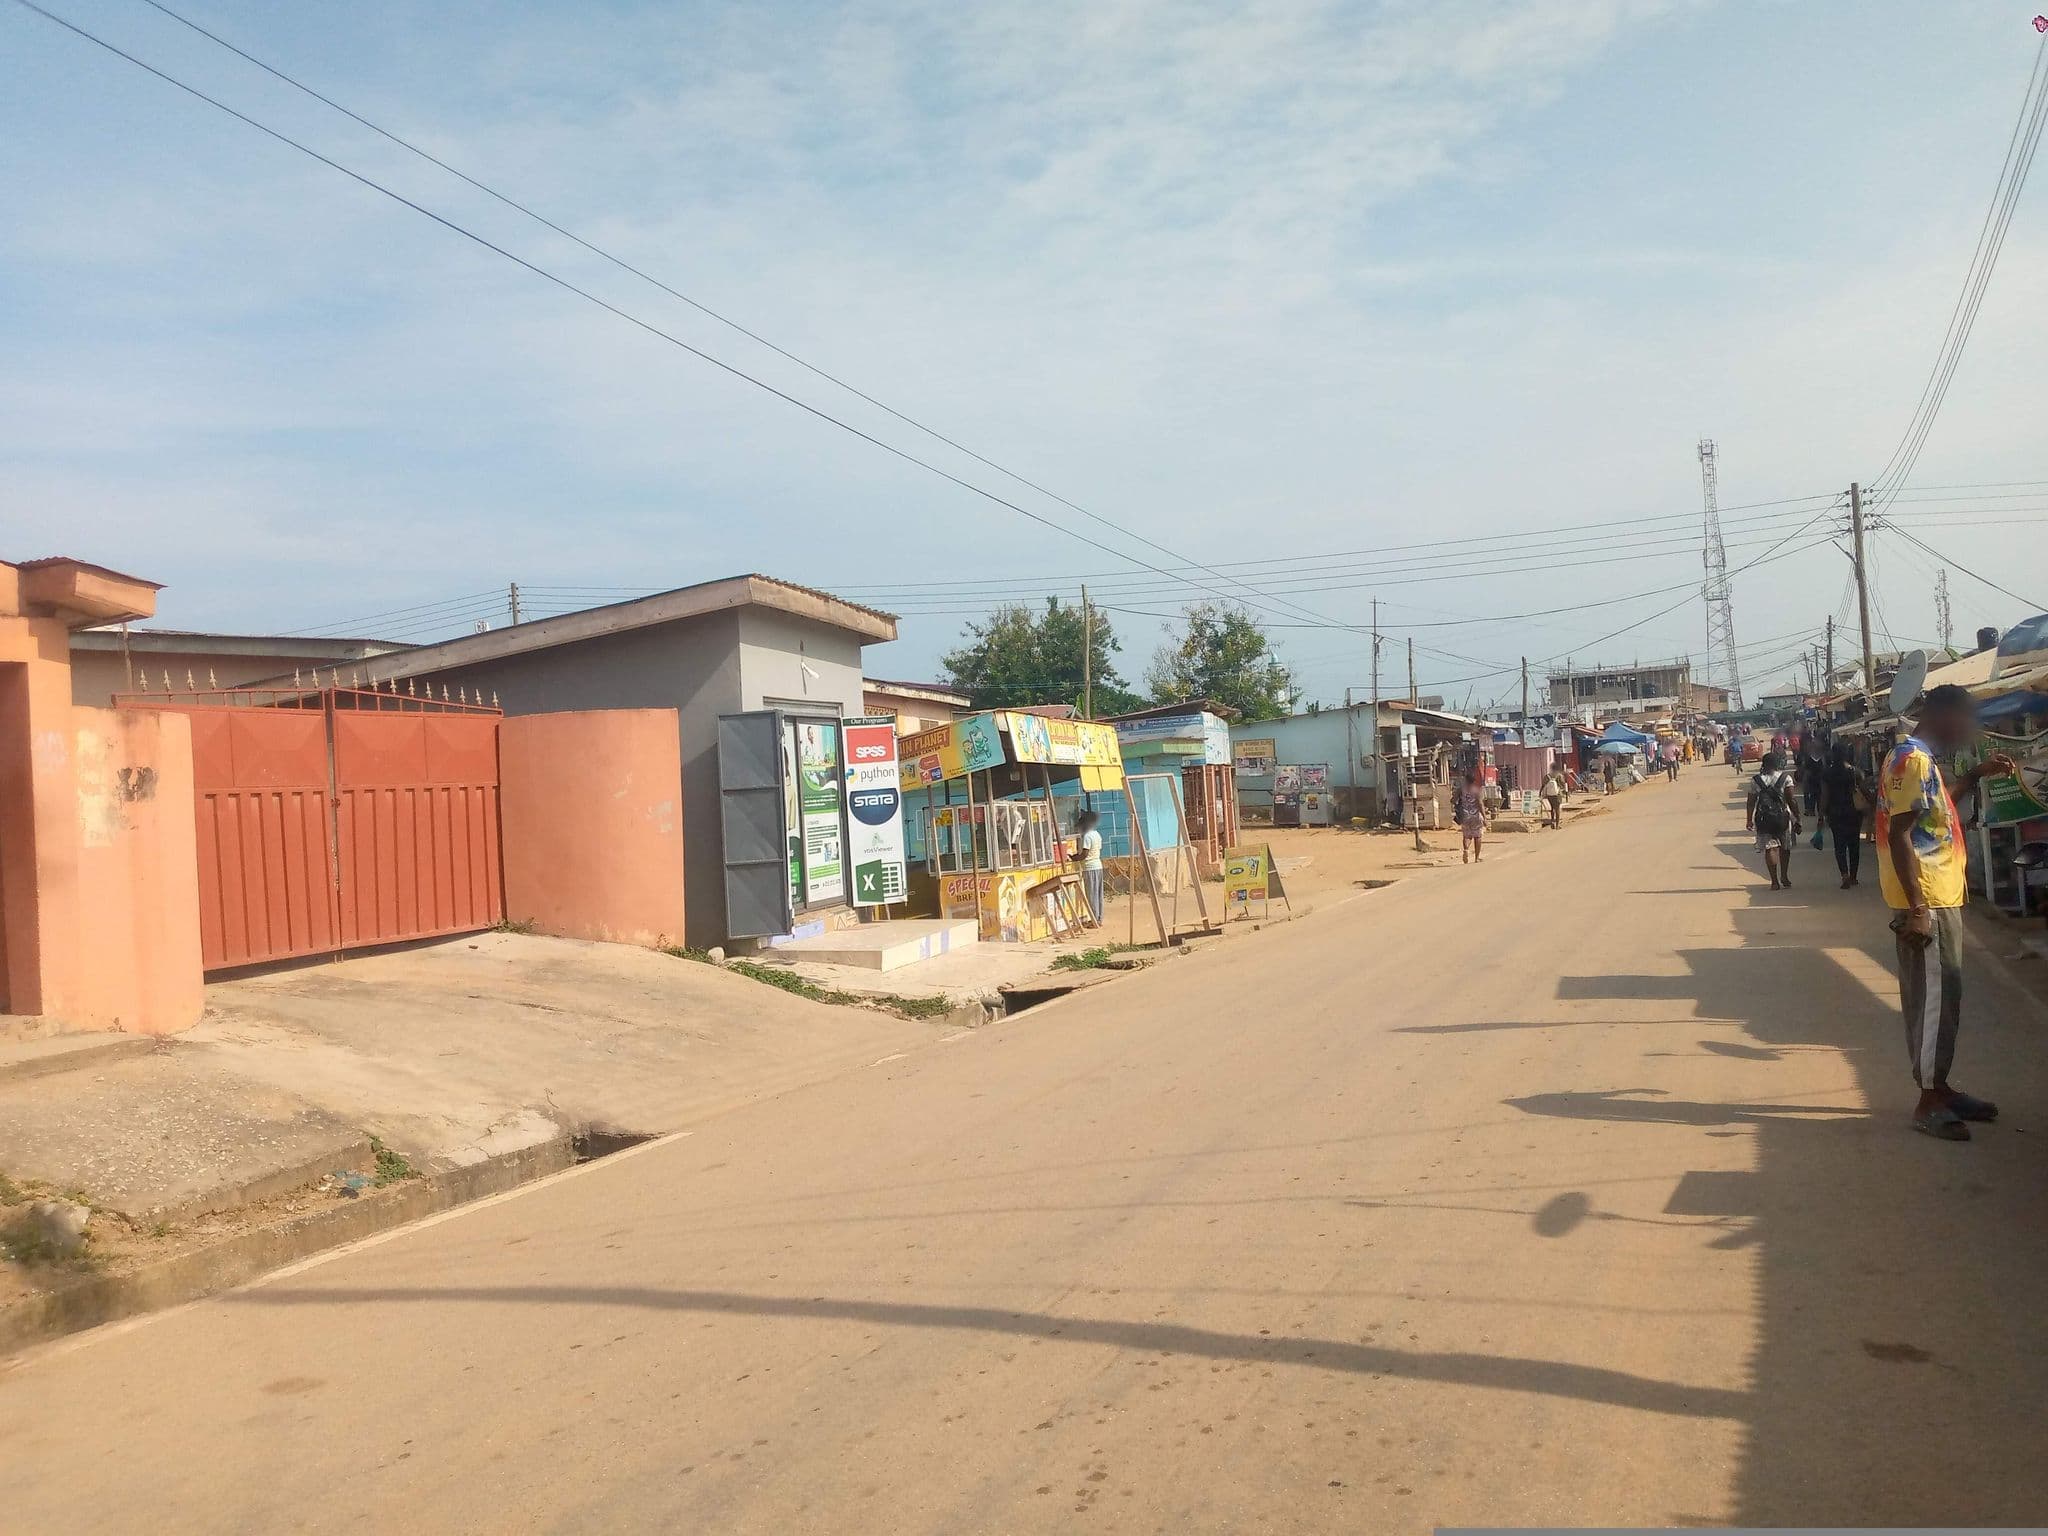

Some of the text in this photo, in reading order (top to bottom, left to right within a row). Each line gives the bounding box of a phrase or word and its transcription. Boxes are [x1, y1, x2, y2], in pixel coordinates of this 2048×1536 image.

[863, 717, 888, 726] Programs
[914, 729, 948, 749] PLANET
[856, 745, 886, 759] SPSS
[860, 766, 895, 783] python
[863, 873, 876, 891] X
[947, 876, 992, 897] SPECAL
[956, 891, 986, 903] BRED
